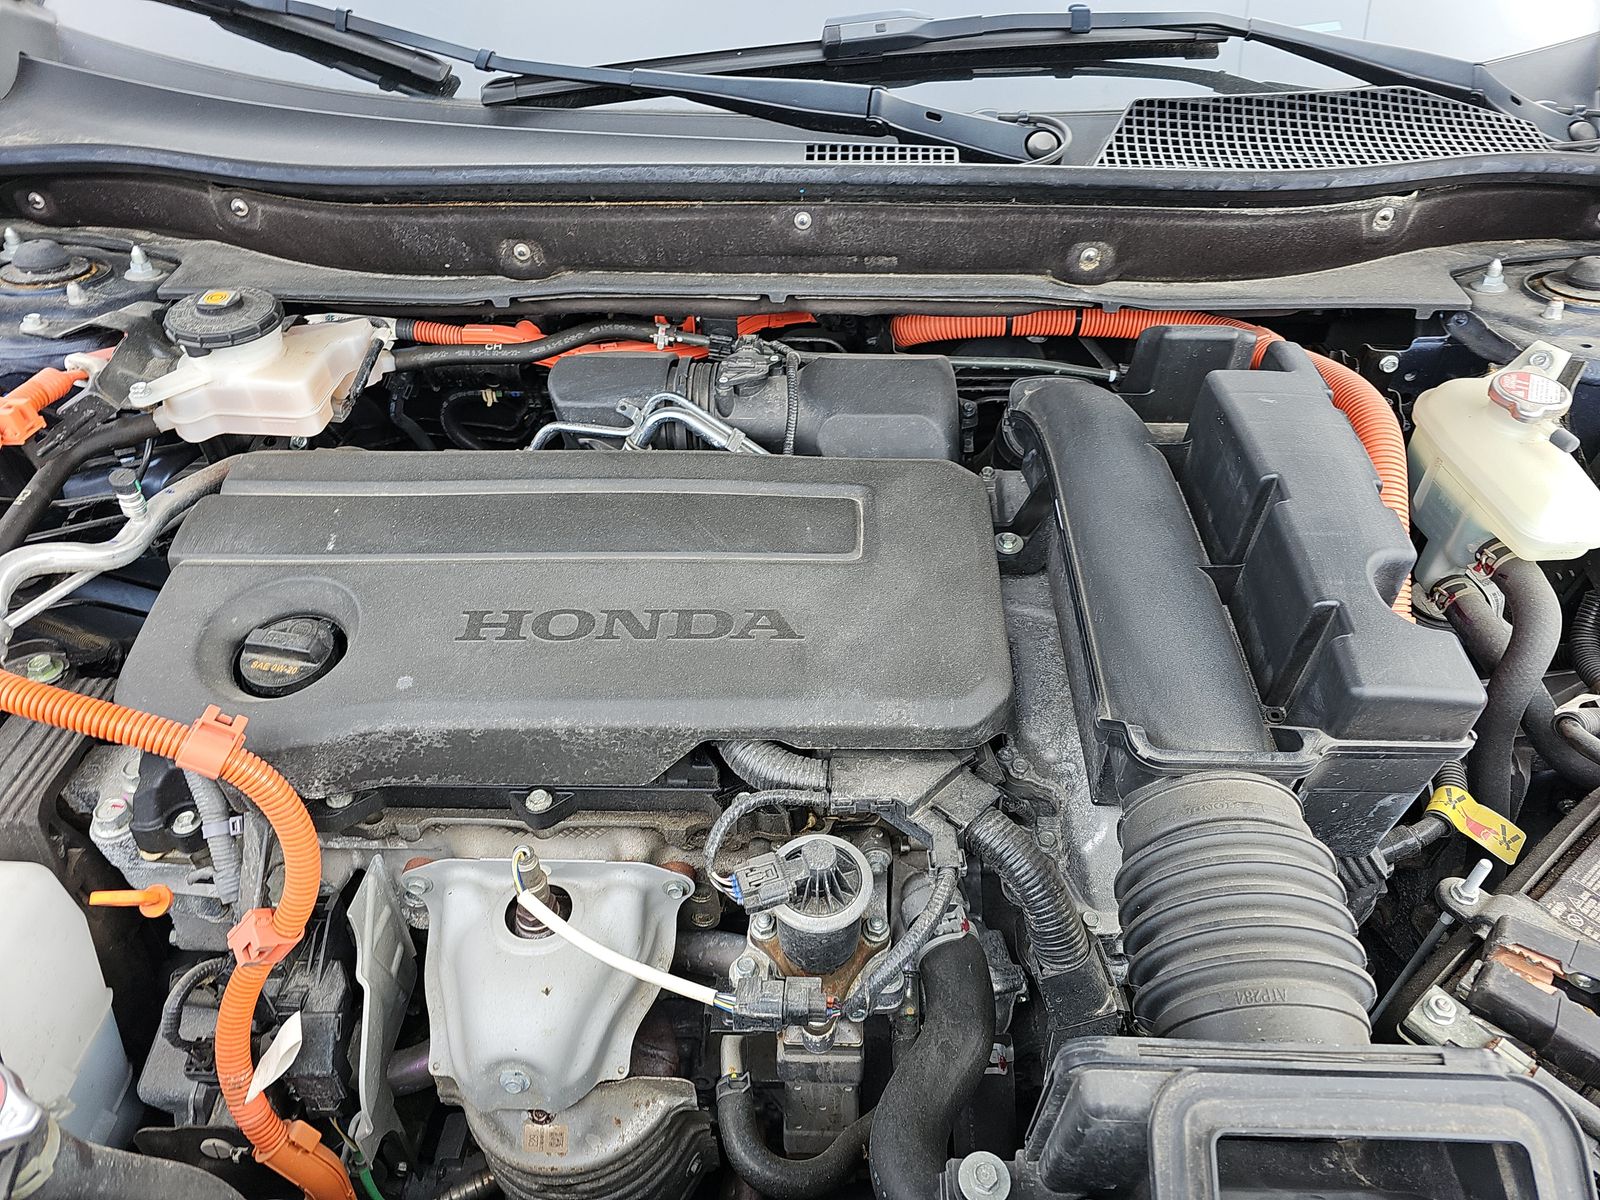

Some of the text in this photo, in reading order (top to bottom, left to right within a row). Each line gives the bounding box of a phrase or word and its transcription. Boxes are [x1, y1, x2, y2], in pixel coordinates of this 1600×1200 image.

[453, 607, 806, 642] HONDA
[250, 660, 298, 675] SAE 0W-20
